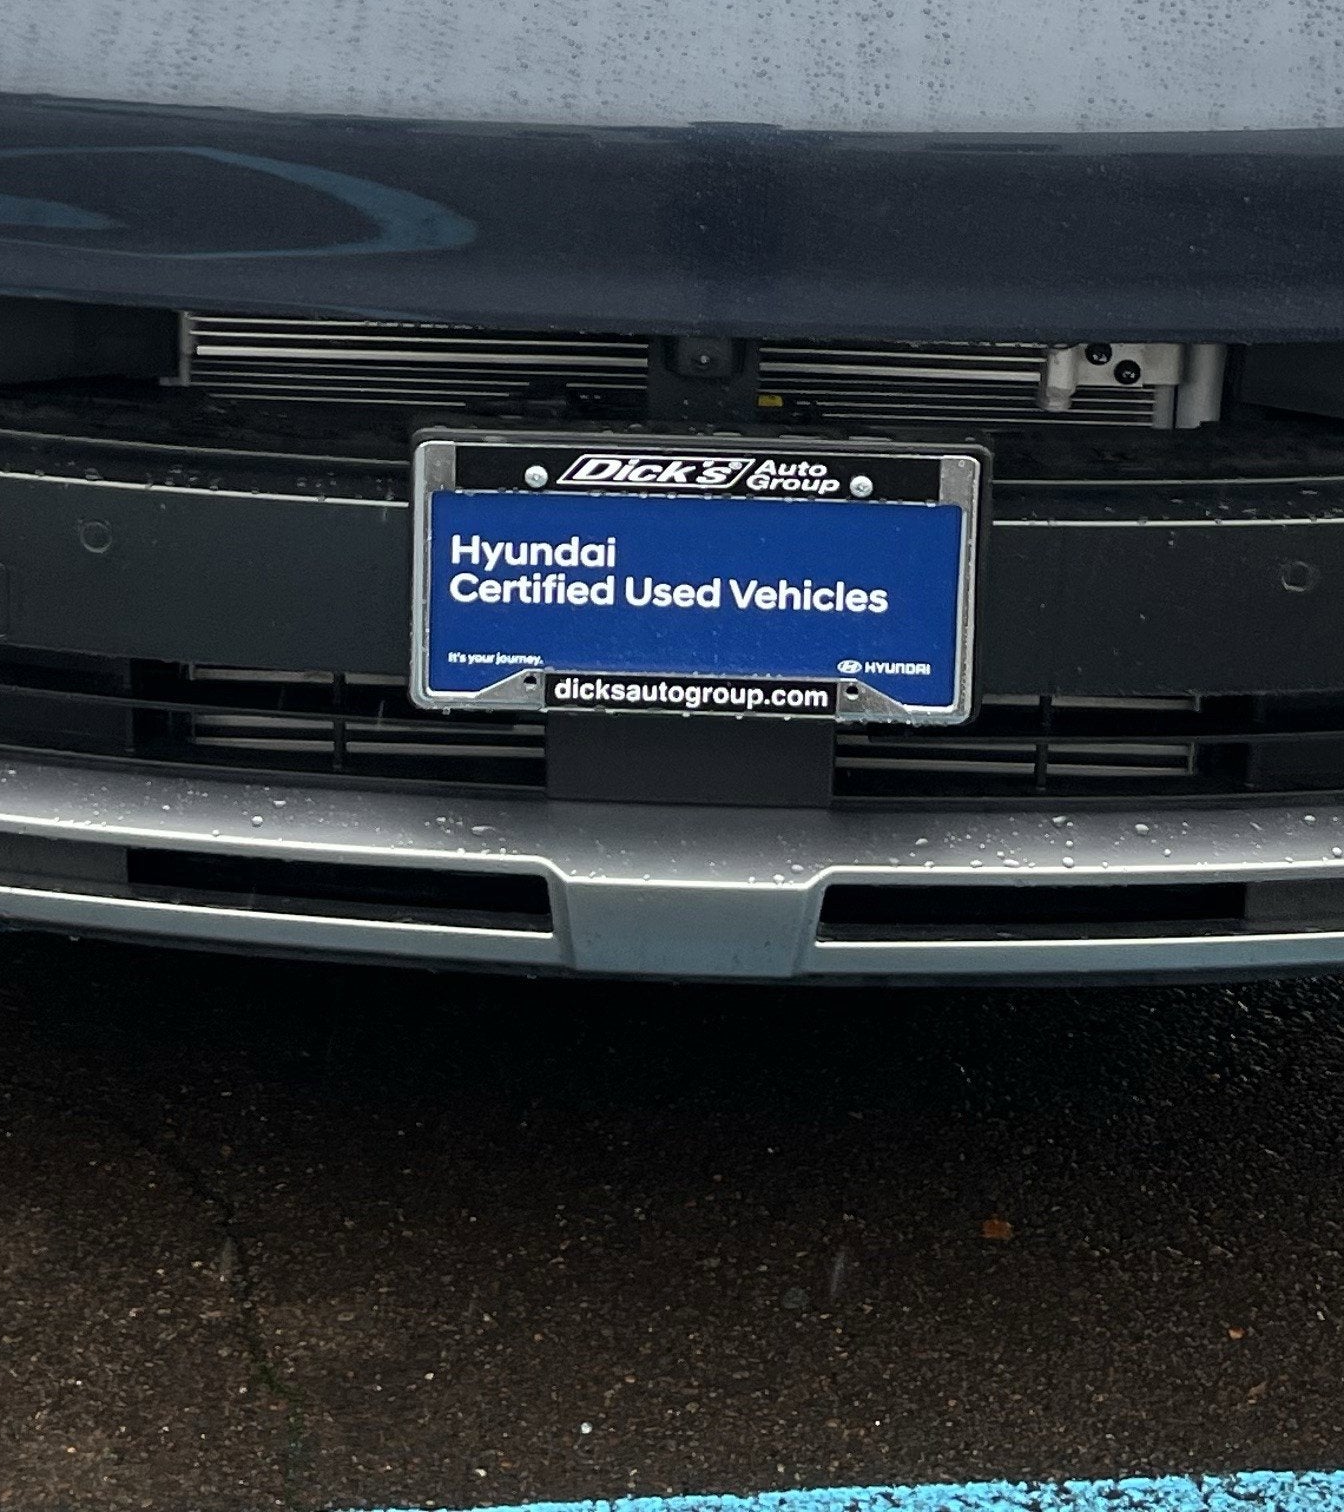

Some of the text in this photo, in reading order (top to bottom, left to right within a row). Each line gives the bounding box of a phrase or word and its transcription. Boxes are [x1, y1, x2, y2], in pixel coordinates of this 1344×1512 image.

[754, 459, 827, 477] Auto
[746, 473, 840, 495] Group
[450, 534, 616, 571] Hyundai
[449, 572, 889, 613] Certified Used Vehicles
[448, 652, 544, 666] It's your journey.
[864, 661, 931, 675] HYUNDAI
[554, 678, 828, 710] dicksautogroup.com
